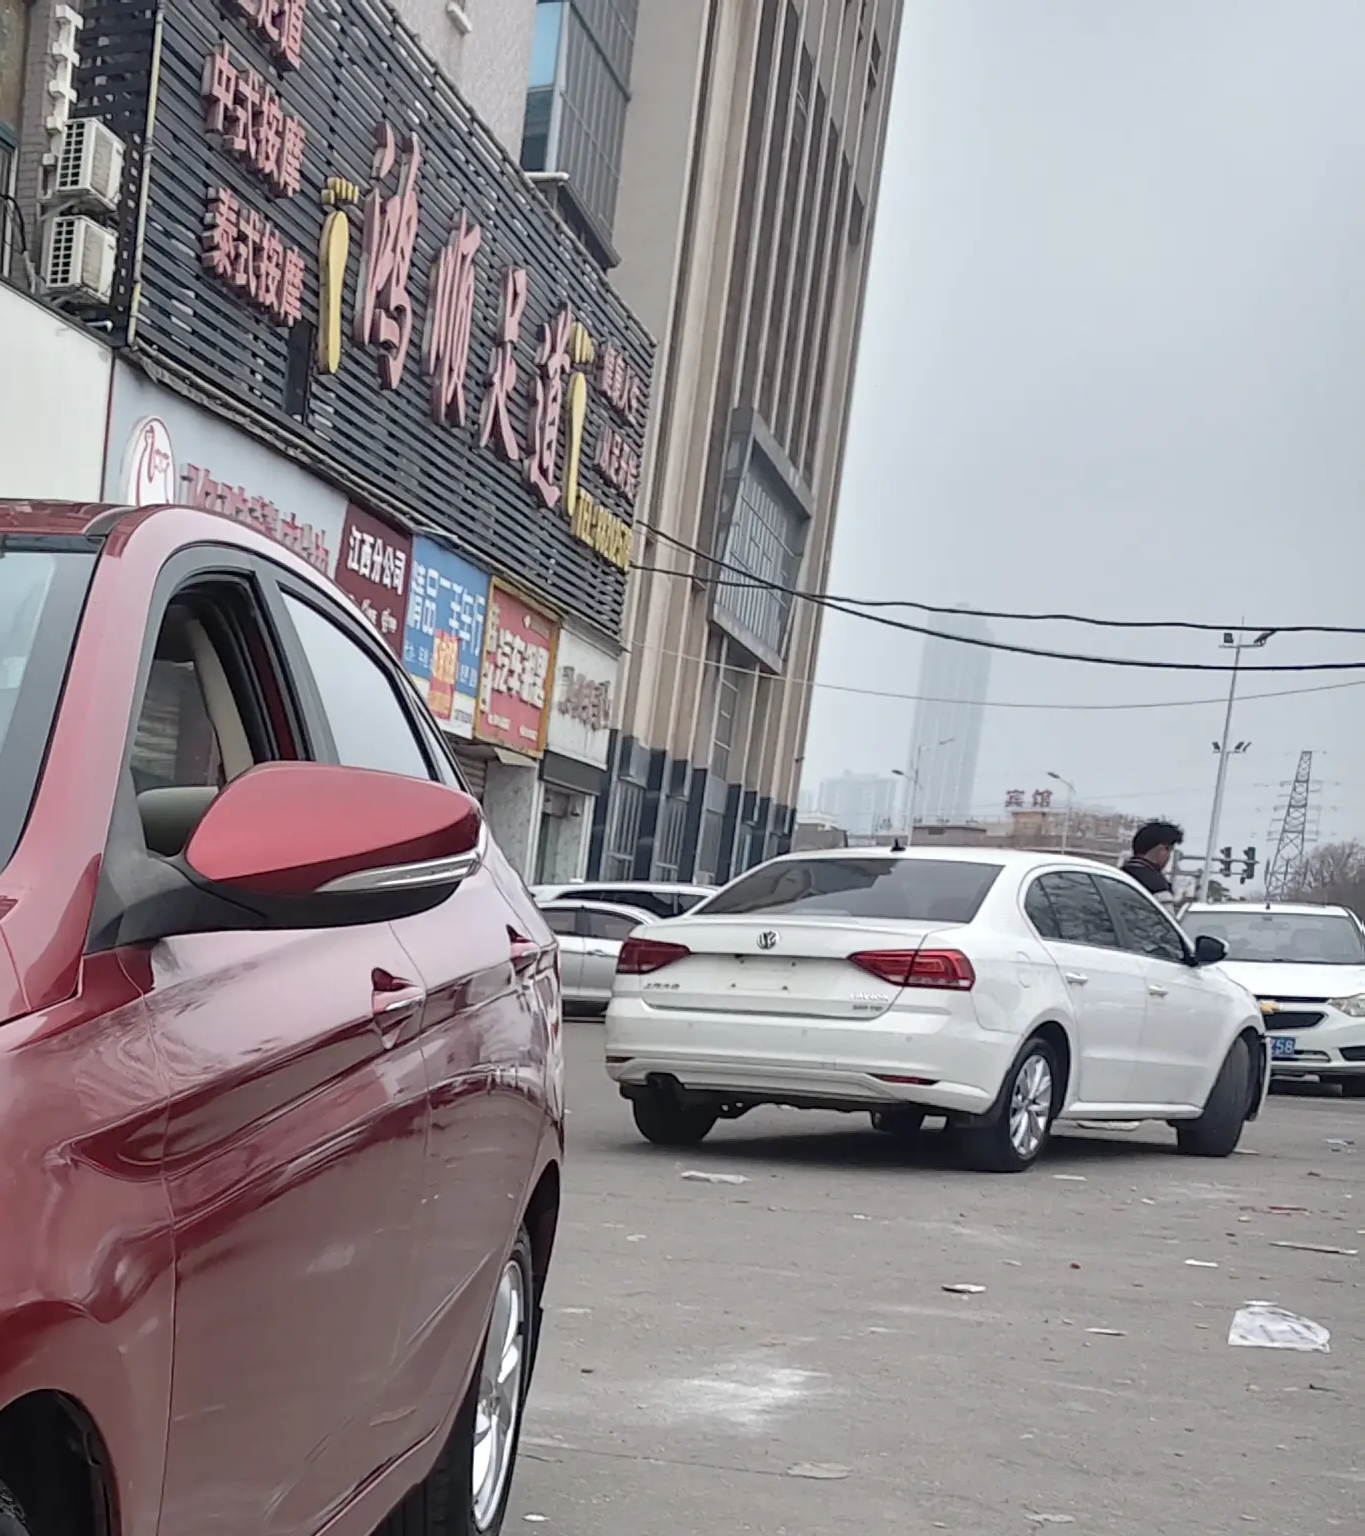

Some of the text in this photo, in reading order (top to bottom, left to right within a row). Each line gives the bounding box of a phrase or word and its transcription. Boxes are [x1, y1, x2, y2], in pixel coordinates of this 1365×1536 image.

[201, 38, 306, 198] 中式按摩
[201, 186, 305, 327] 泰式按摩
[347, 525, 407, 596] 江西分公司
[407, 559, 486, 658] 精品二手车行
[1005, 788, 1053, 808] 宾馆
